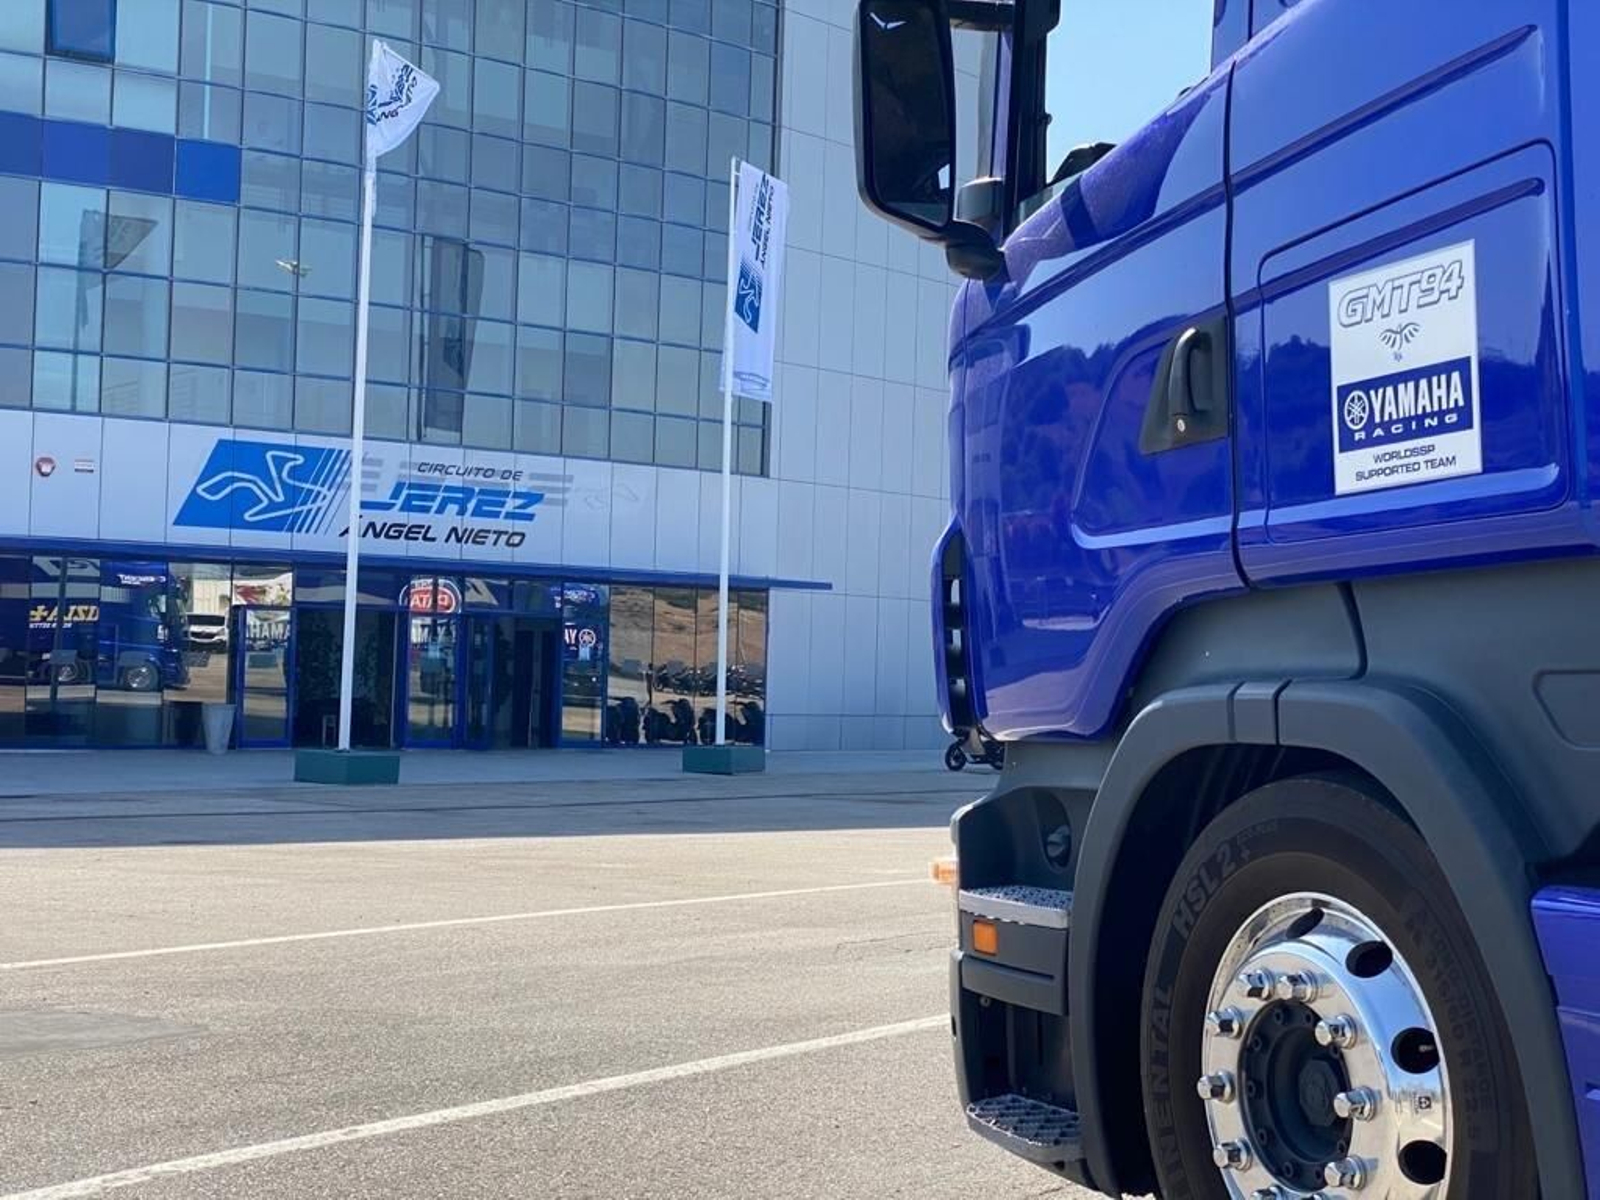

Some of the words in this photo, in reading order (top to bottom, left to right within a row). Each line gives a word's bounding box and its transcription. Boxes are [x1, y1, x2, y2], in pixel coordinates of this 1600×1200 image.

[1337, 259, 1465, 329] GMT94
[1369, 370, 1465, 424] YAMAHA
[1354, 414, 1459, 442] RACING
[1373, 443, 1436, 464] WORLDSSP
[417, 461, 496, 479] CIRCUITO
[499, 469, 524, 482] DE
[1355, 460, 1421, 482] SUPPORTED
[1425, 455, 1457, 471] TEAM
[360, 481, 545, 522] JEREZ
[444, 526, 526, 548] NIETO
[1173, 865, 1221, 939] HSL
